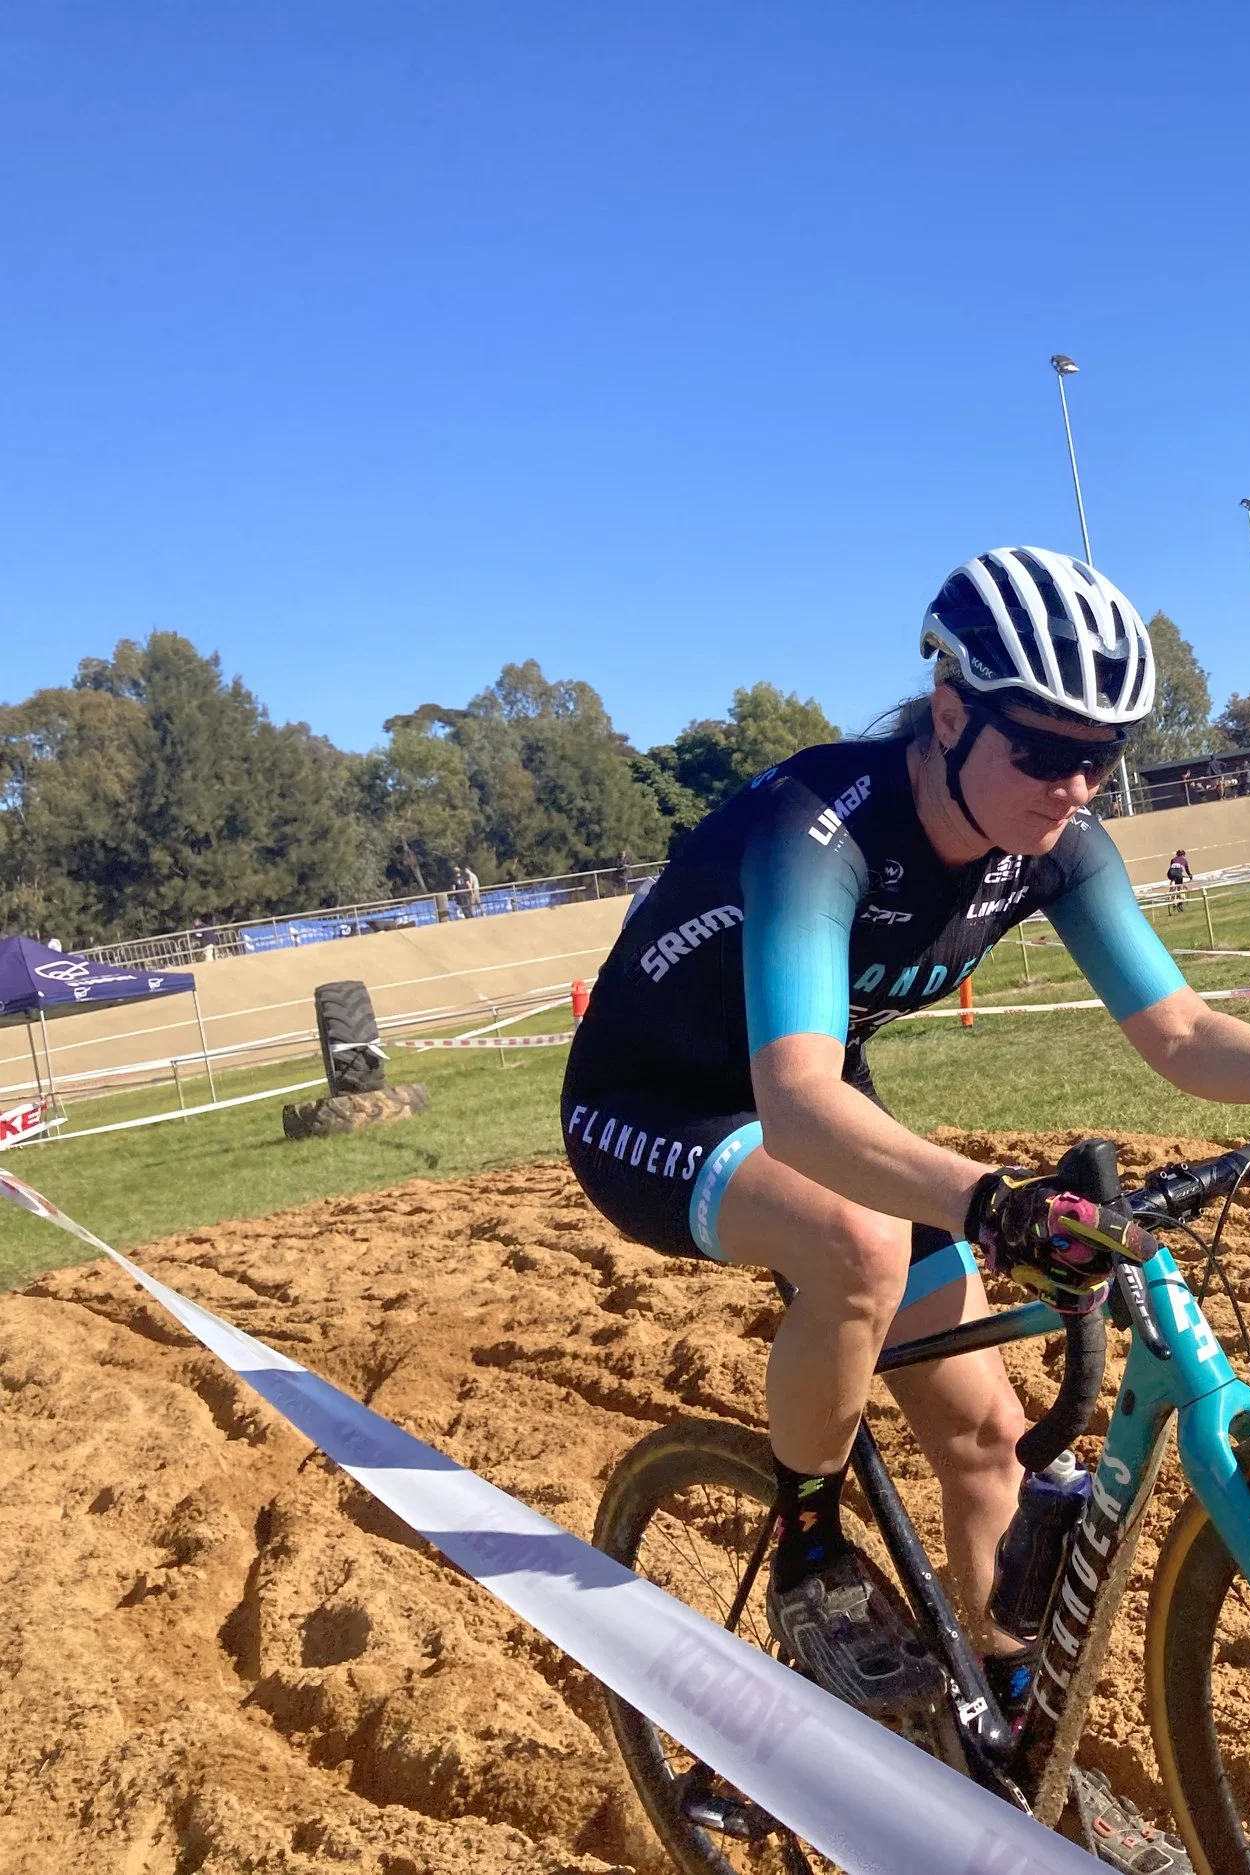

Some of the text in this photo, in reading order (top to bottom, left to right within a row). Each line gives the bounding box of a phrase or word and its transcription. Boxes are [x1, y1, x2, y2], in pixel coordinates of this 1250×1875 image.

[640, 904, 744, 983] SRAM
[568, 1105, 703, 1181] FLANDERS
[1032, 1454, 1131, 1721] FLANDERS
